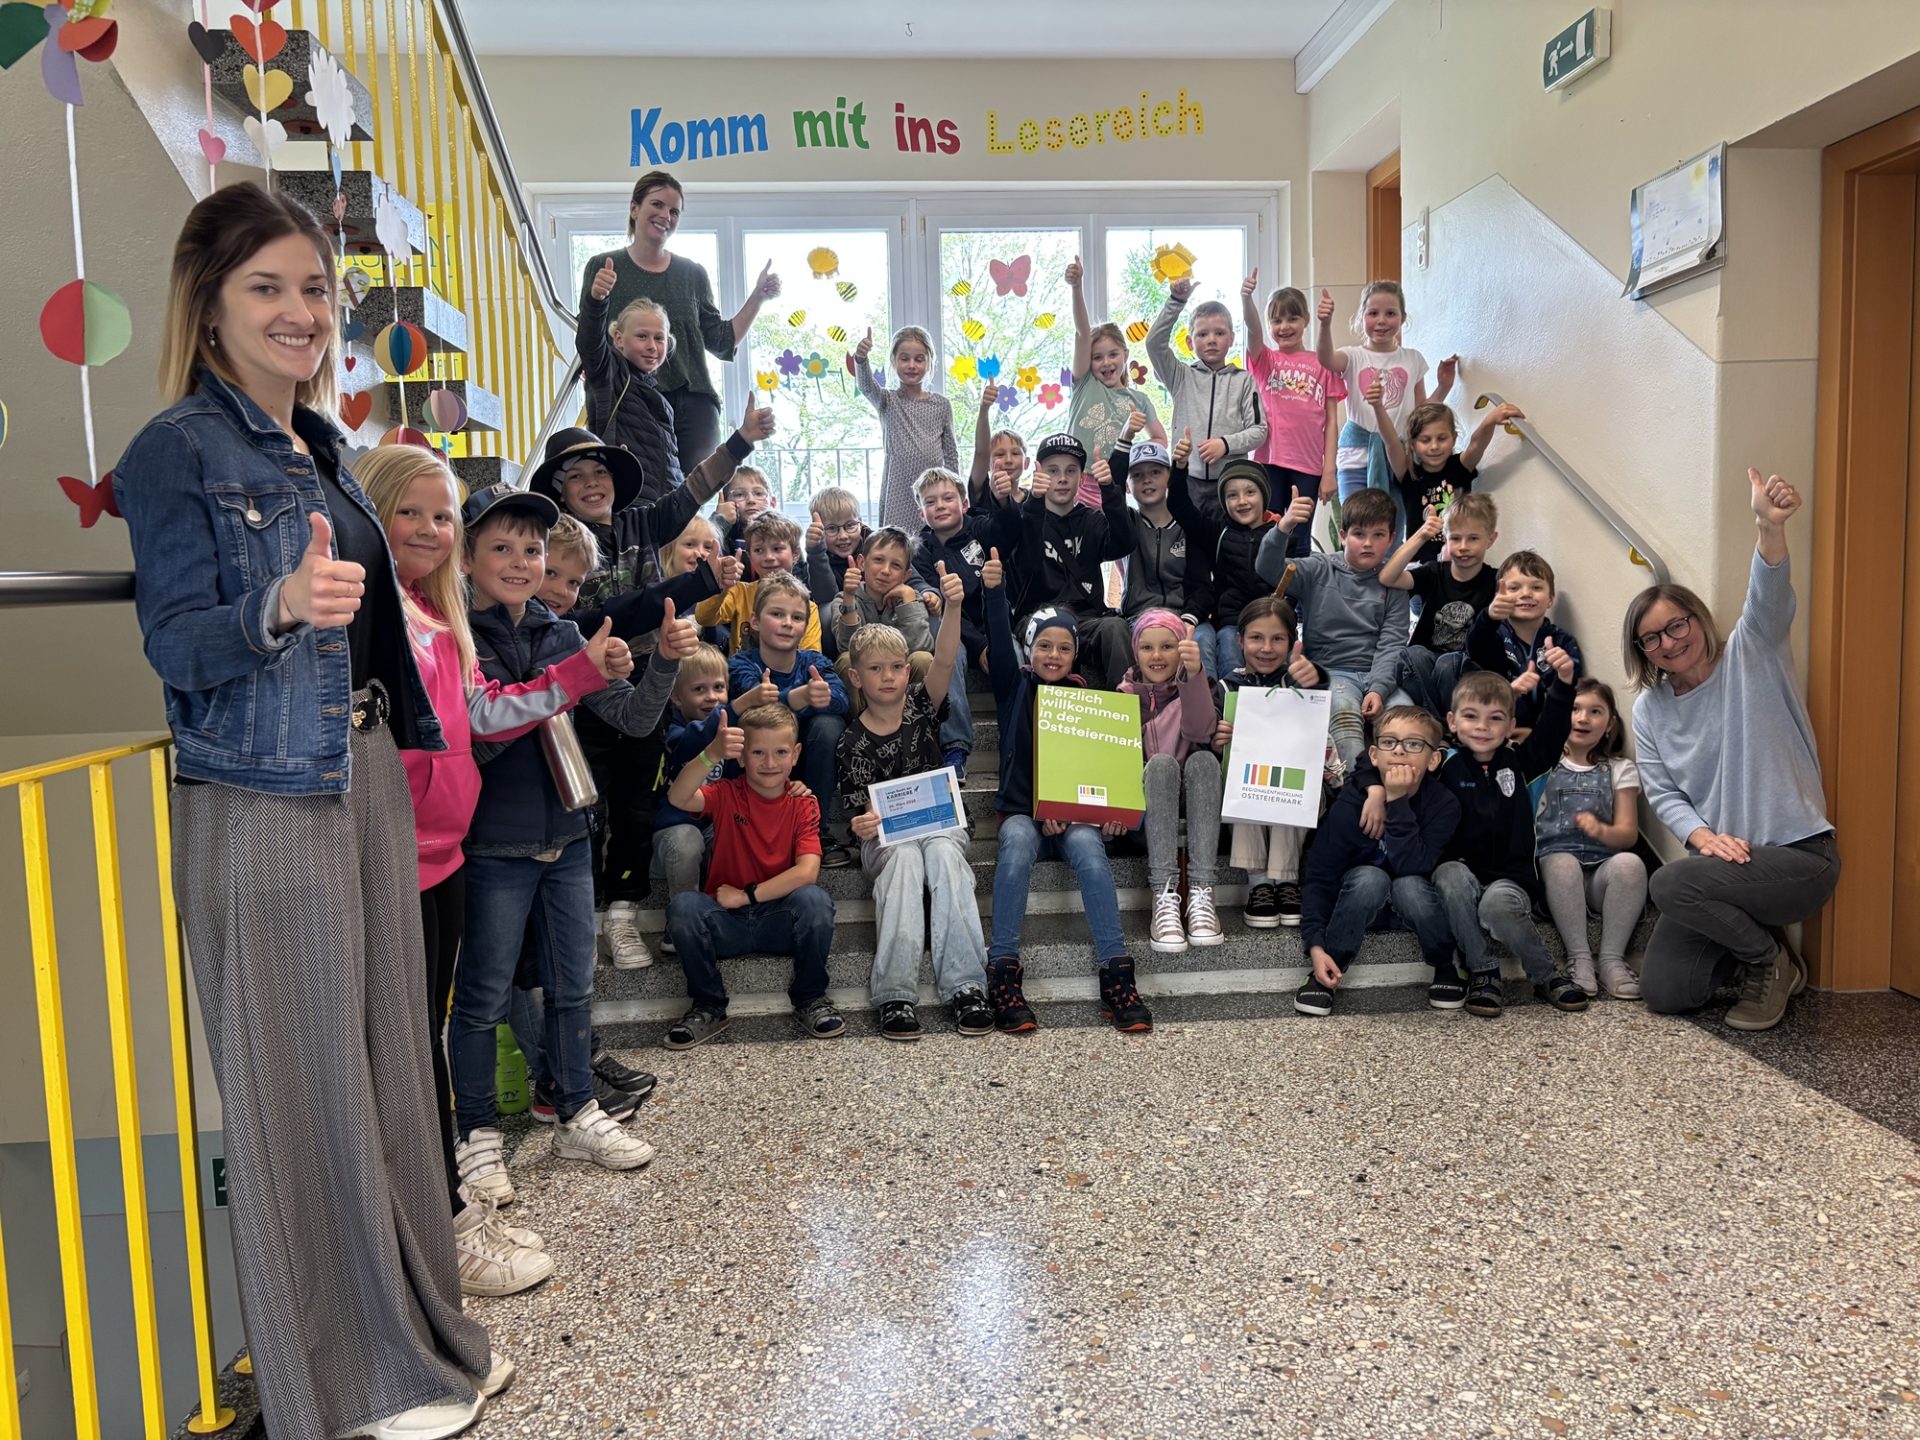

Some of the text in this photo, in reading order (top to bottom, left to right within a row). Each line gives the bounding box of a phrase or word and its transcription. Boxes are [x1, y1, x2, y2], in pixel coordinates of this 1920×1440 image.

[629, 87, 1205, 168] Komm mit ins Lesereich
[1043, 685, 1103, 705] Herzlich
[1039, 707, 1082, 724] in der
[1041, 698, 1130, 722] willkommen
[1038, 719, 1143, 749] Oststeiermark
[886, 790, 913, 800] KARRIERE
[1241, 792, 1303, 806] OSTSTEIERMARK
